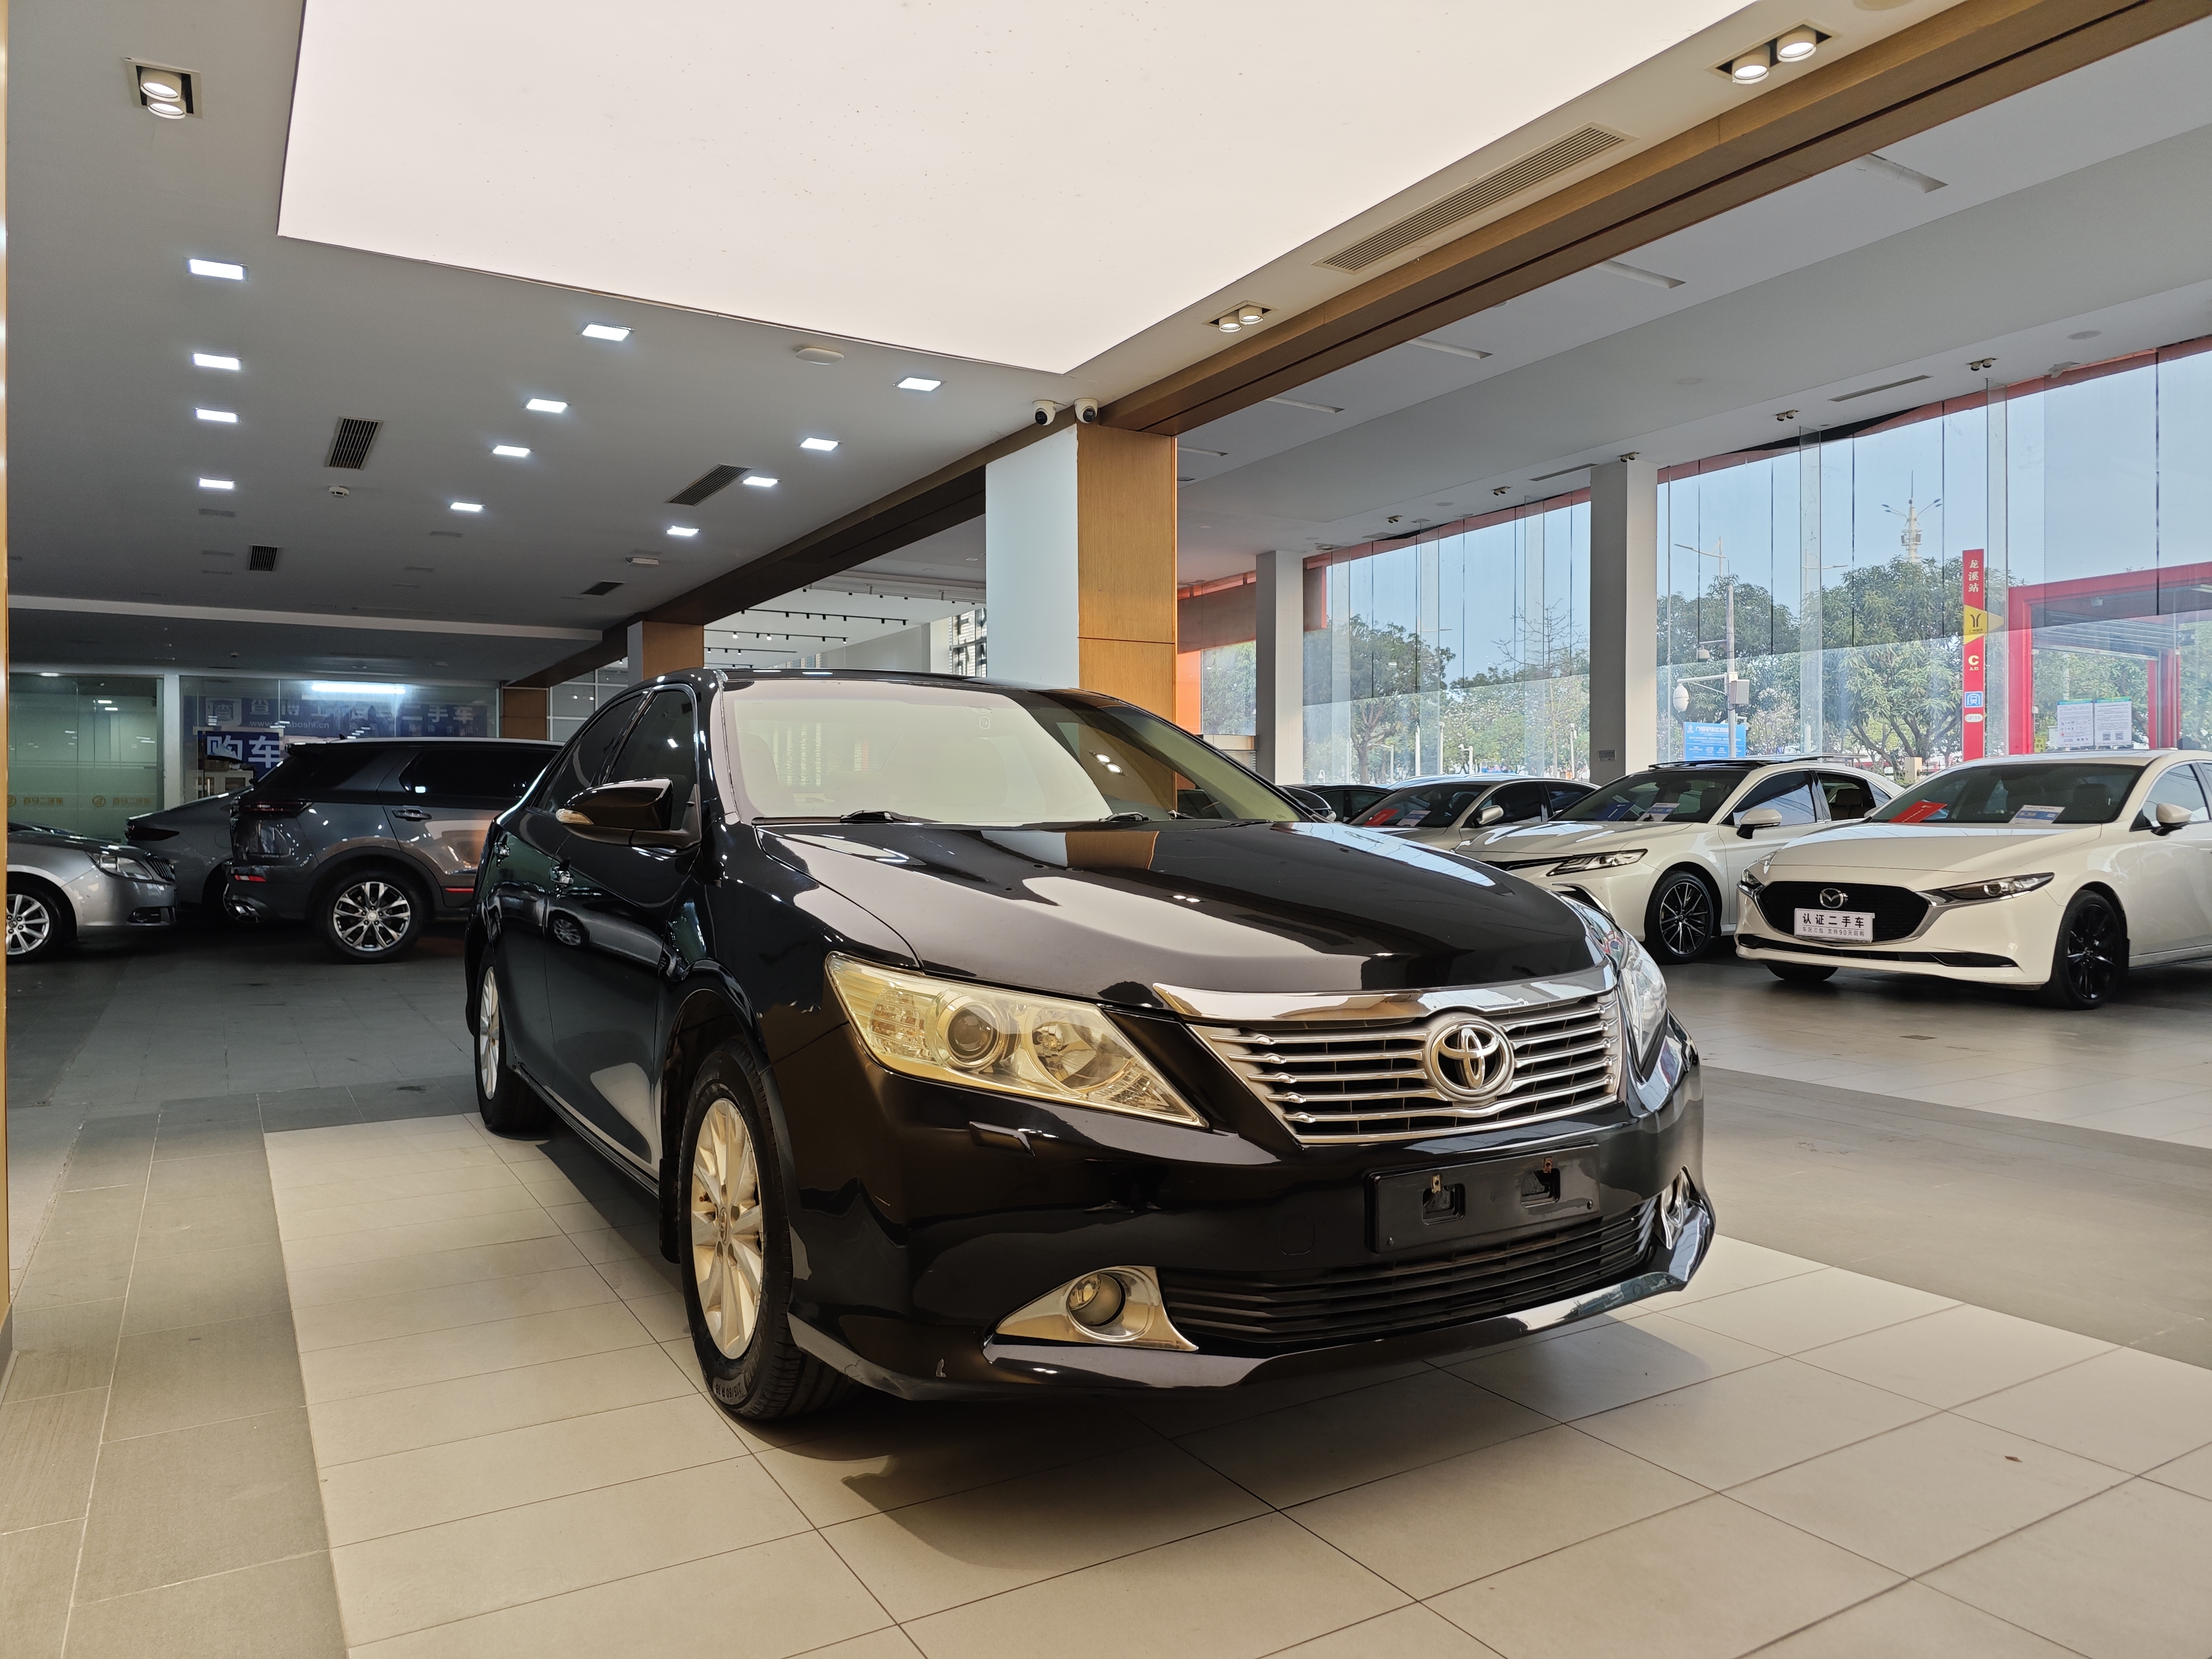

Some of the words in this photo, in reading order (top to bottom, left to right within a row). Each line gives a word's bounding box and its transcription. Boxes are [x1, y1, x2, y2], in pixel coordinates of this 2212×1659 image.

[1968, 559, 1979, 592] 龙溪站
[1968, 655, 1979, 665] C
[207, 734, 281, 768] 购车
[1803, 913, 1864, 928] 认证二手车
[1827, 928, 1865, 937] 支持90天回购
[726, 1382, 741, 1398] 215/60
